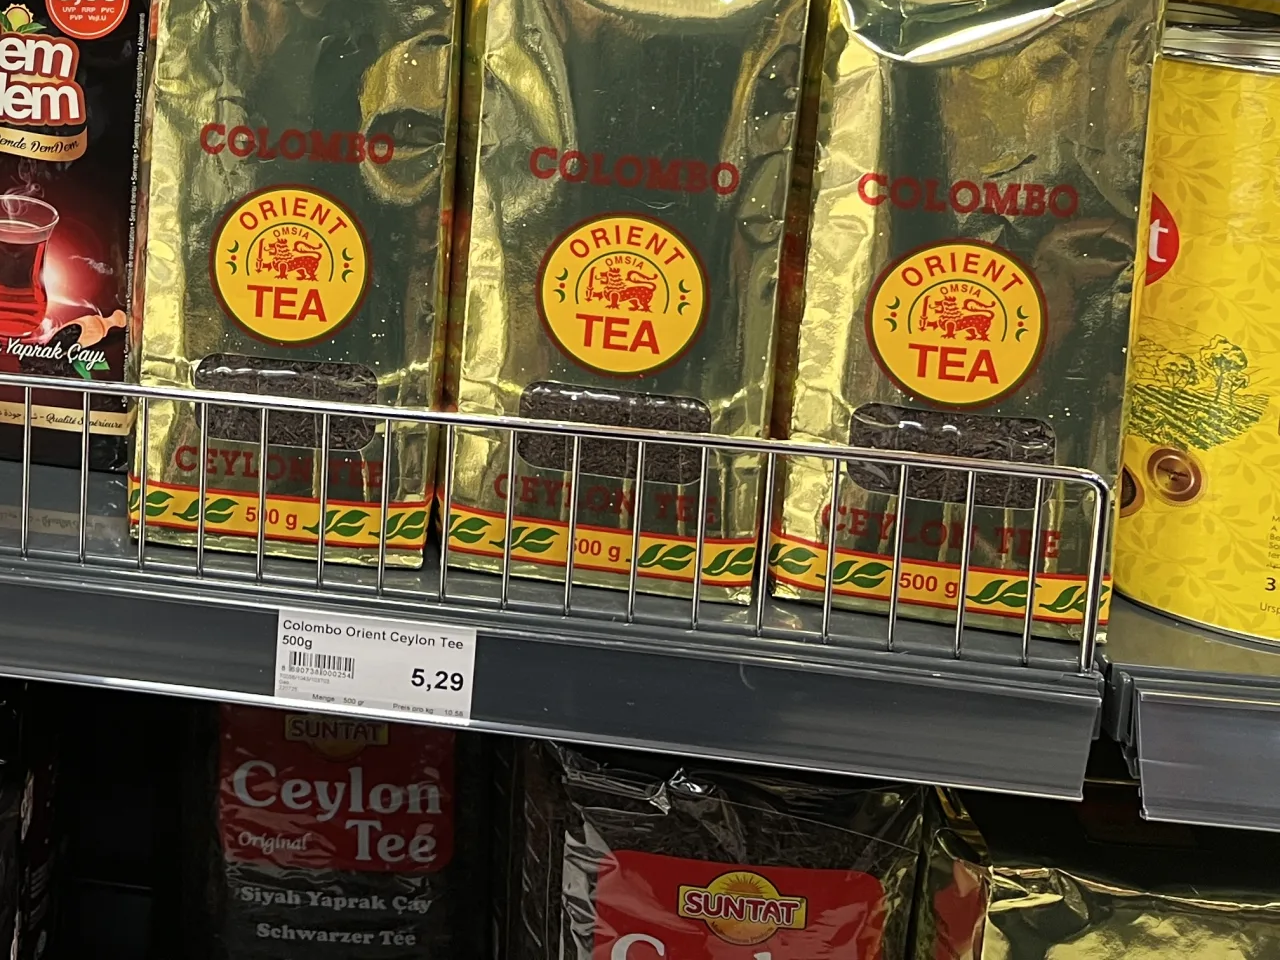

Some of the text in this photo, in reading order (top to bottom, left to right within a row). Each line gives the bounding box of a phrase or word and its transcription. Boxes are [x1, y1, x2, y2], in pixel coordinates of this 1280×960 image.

[199, 122, 395, 166] COLOMBO
[528, 145, 741, 197] COLOMBO
[857, 171, 1079, 219] COLOMBO
[239, 195, 349, 236] ORIENT
[272, 226, 310, 241] OMSIA
[569, 223, 688, 266] ORIENT
[900, 251, 1025, 294] ORIENT
[246, 283, 328, 324] TEA
[939, 282, 982, 298] OMSIA
[6, 335, 65, 363] Yaprak
[575, 313, 661, 356] TEA
[908, 342, 1000, 386] TEA
[898, 570, 959, 600] 500 g
[281, 634, 313, 650] 500g
[282, 619, 464, 650] Colombo Orient Ceylon Tee
[410, 667, 465, 692] 5,29
[288, 718, 384, 741] SUNTAT
[231, 758, 443, 822] Ceylon
[237, 830, 312, 855] Original
[239, 886, 434, 915] Siyah Yaprak Çay
[681, 889, 801, 927] SUNTAT
[255, 921, 375, 946] Schwarzer
